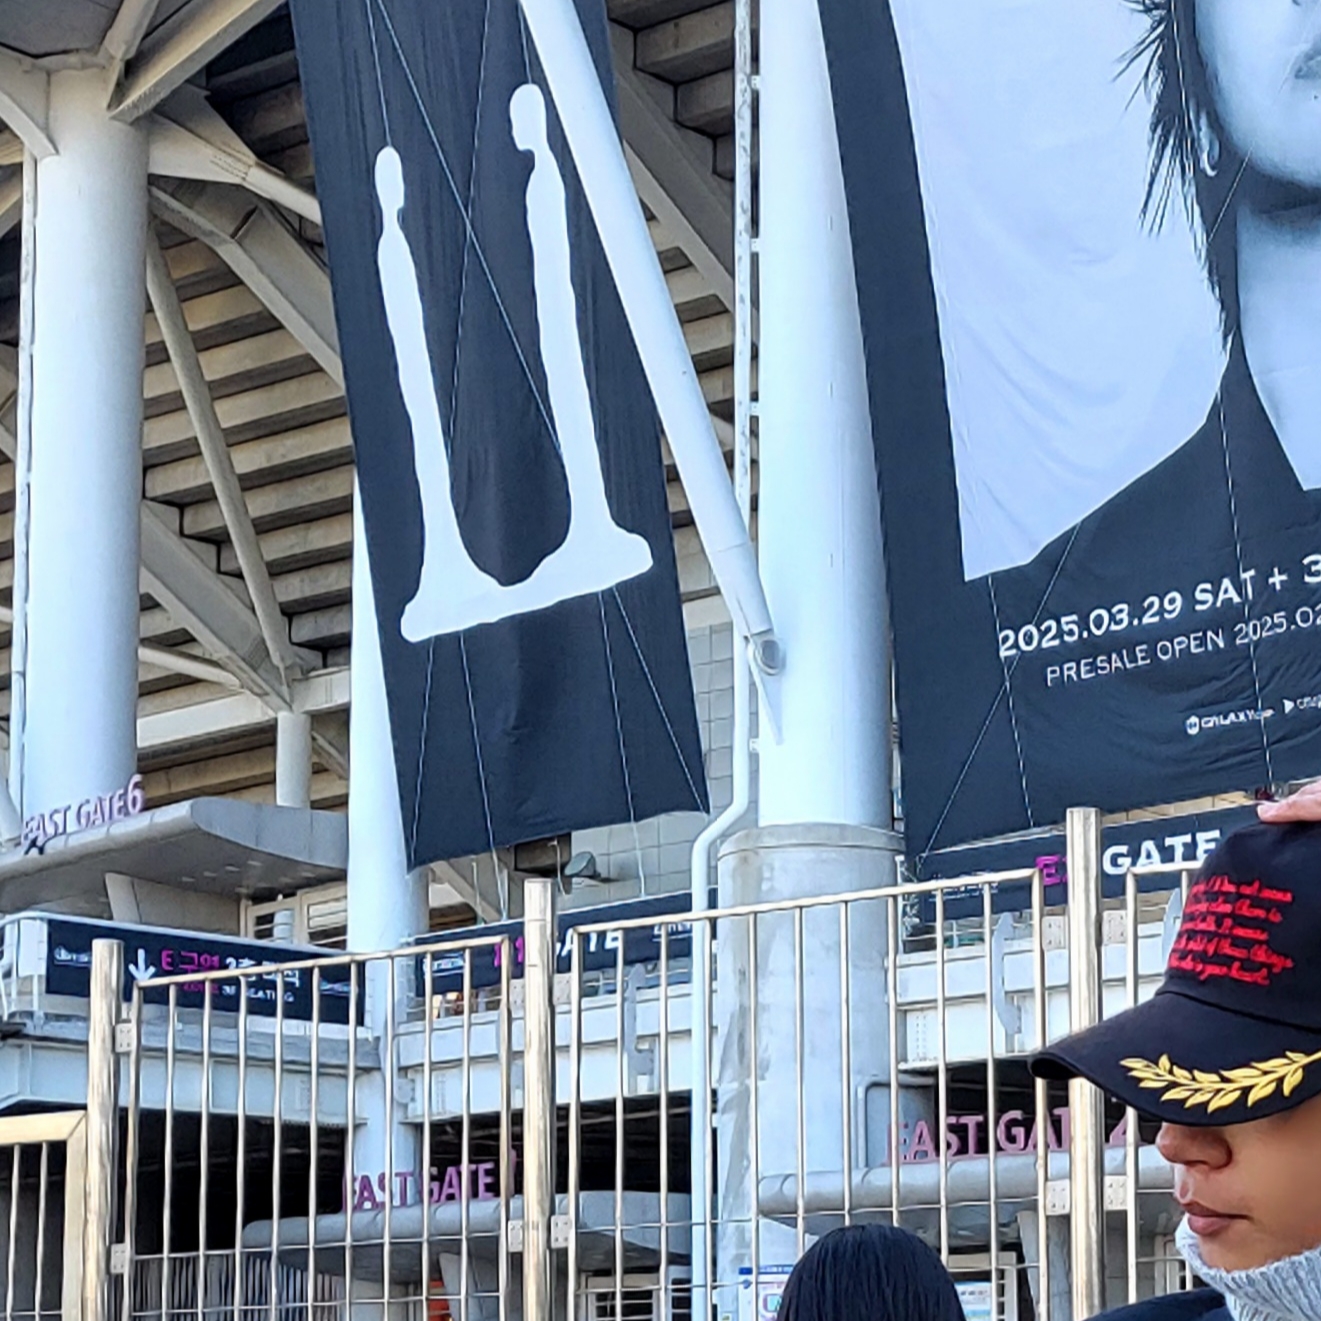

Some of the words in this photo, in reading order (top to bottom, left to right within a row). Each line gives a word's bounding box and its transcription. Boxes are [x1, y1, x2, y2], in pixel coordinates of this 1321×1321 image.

[998, 591, 1183, 658] 2025.03.29
[1194, 570, 1257, 612] SAT
[1046, 643, 1150, 687] PRESALE
[1156, 628, 1225, 662] OPEN
[20, 804, 71, 847] EAST
[1036, 854, 1067, 885] E
[1102, 829, 1221, 876] GATE
